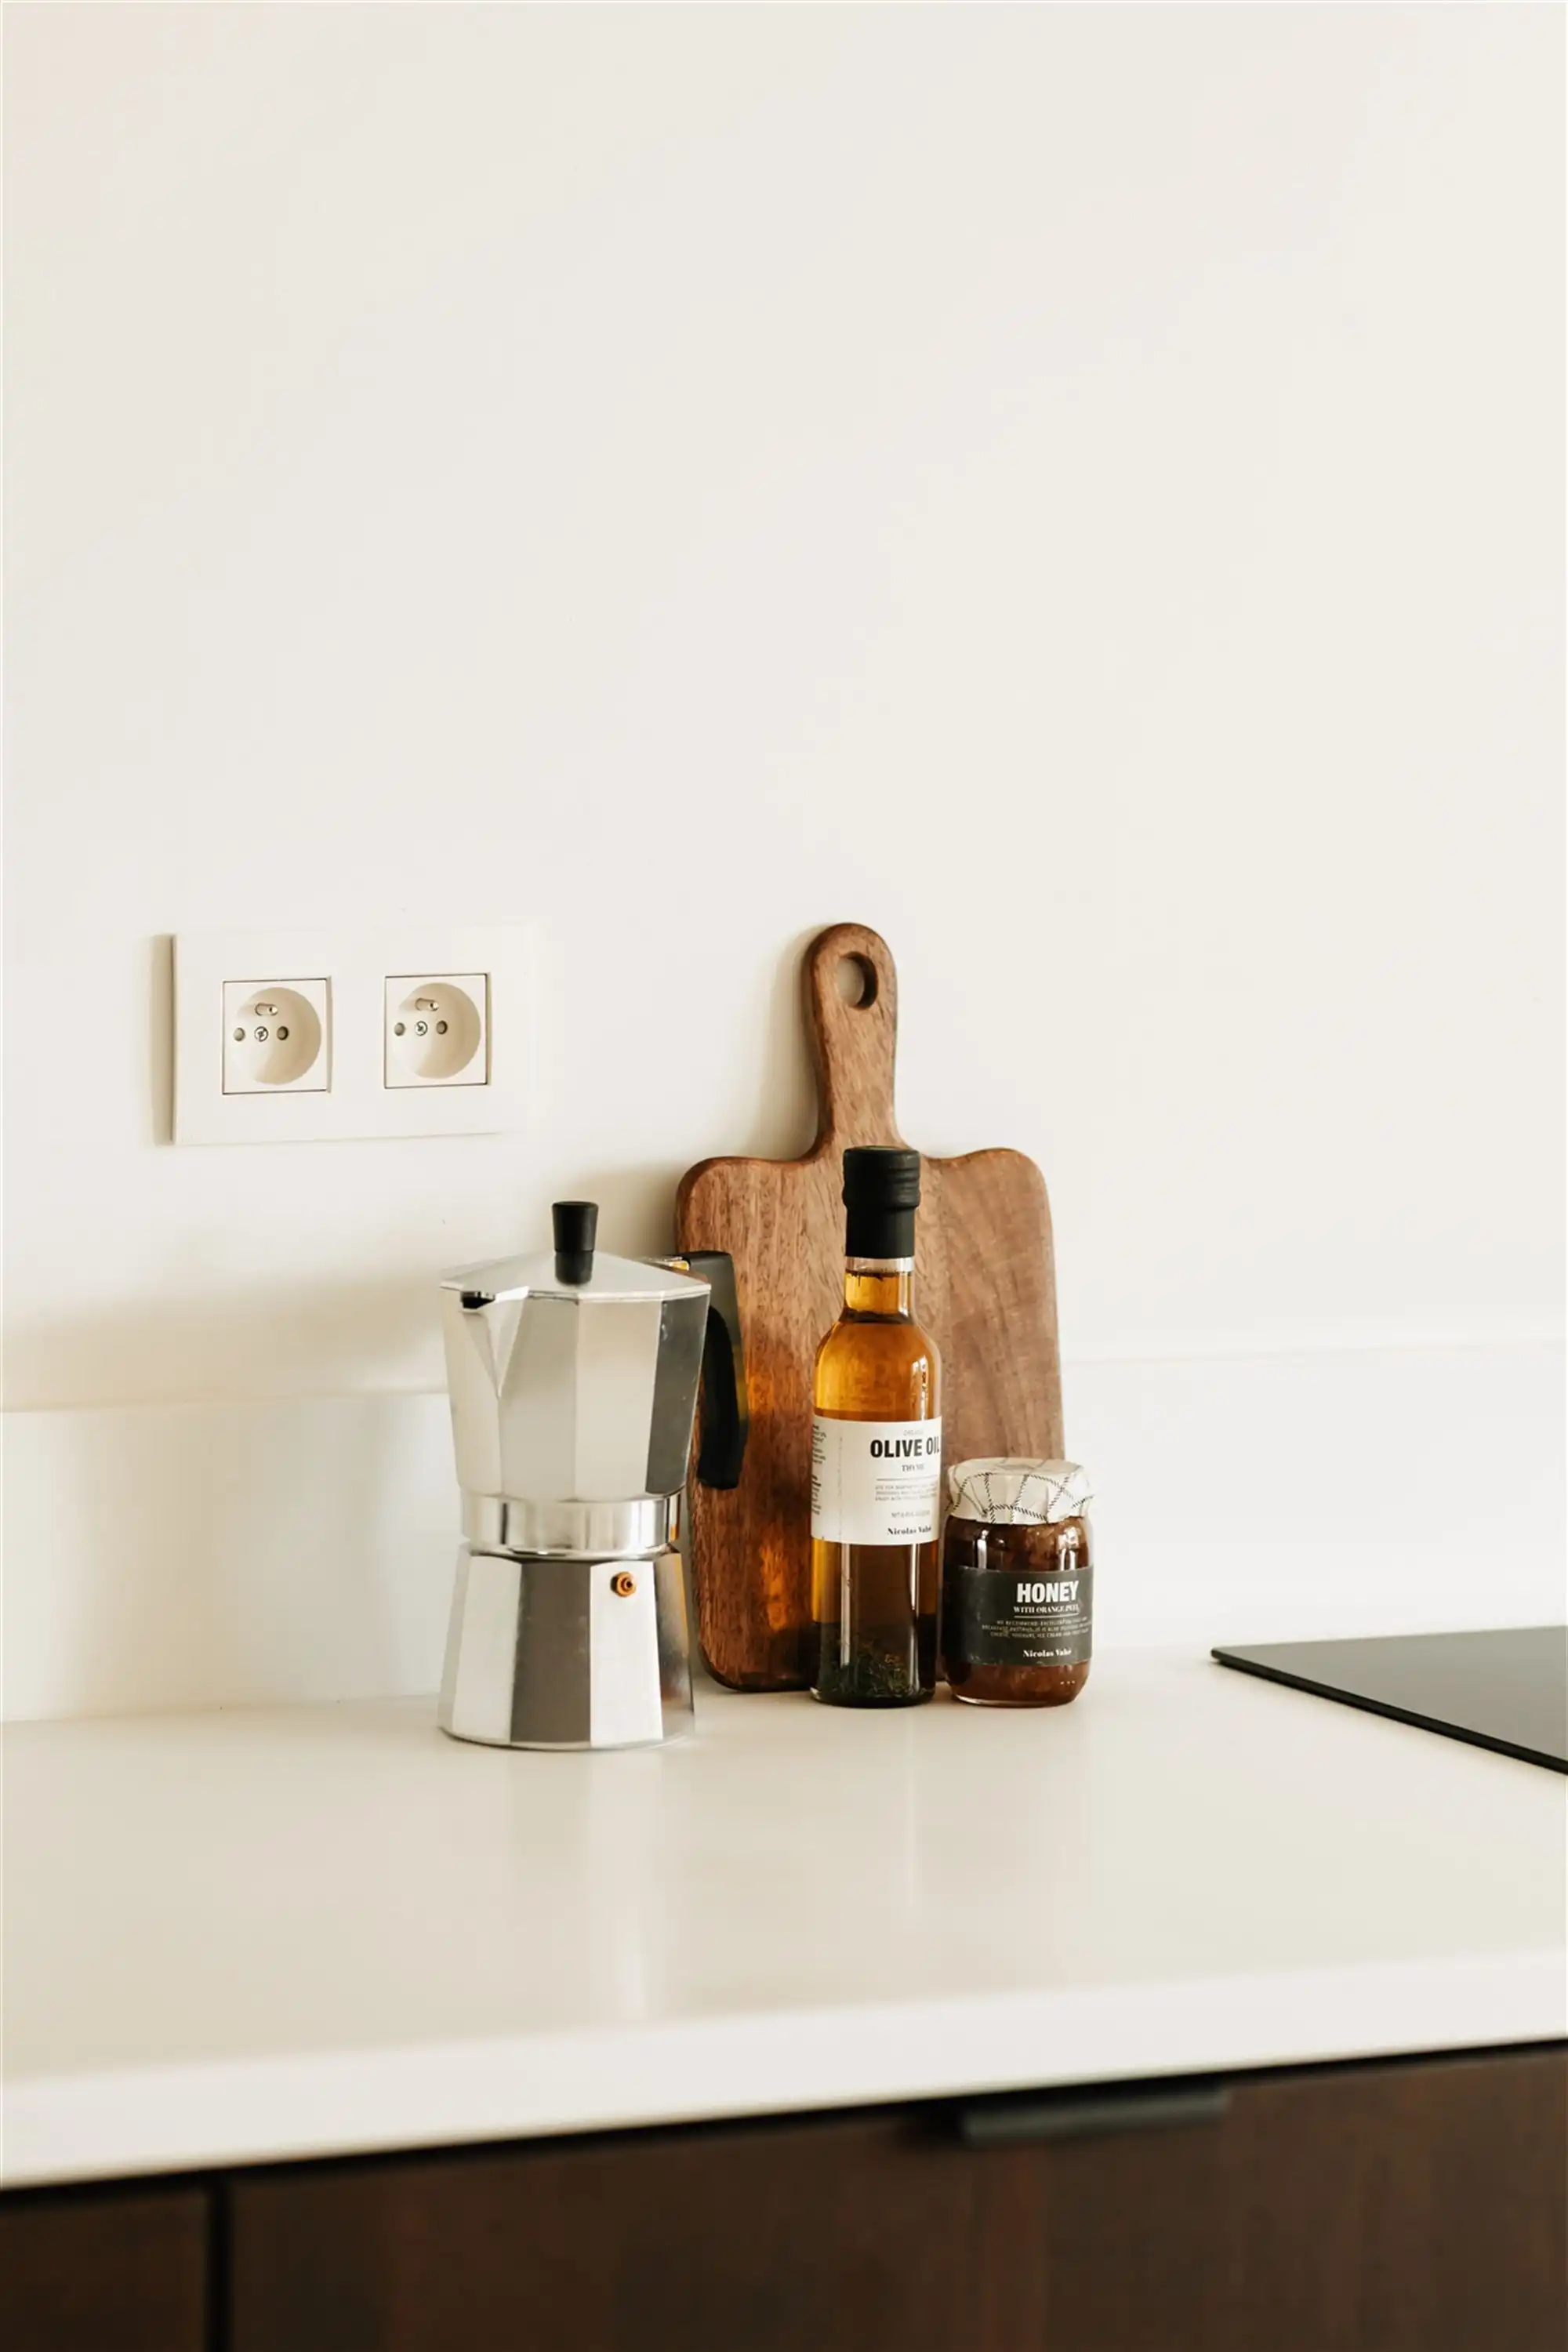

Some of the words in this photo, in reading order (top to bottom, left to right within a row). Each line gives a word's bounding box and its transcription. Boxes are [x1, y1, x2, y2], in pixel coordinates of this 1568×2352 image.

[870, 1439, 923, 1458] OLIVE
[926, 1436, 940, 1455] OIL
[1016, 1580, 1080, 1603] HONEY
[1036, 1604, 1065, 1613] ORANGE
[1023, 1649, 1054, 1657] Nicolas
